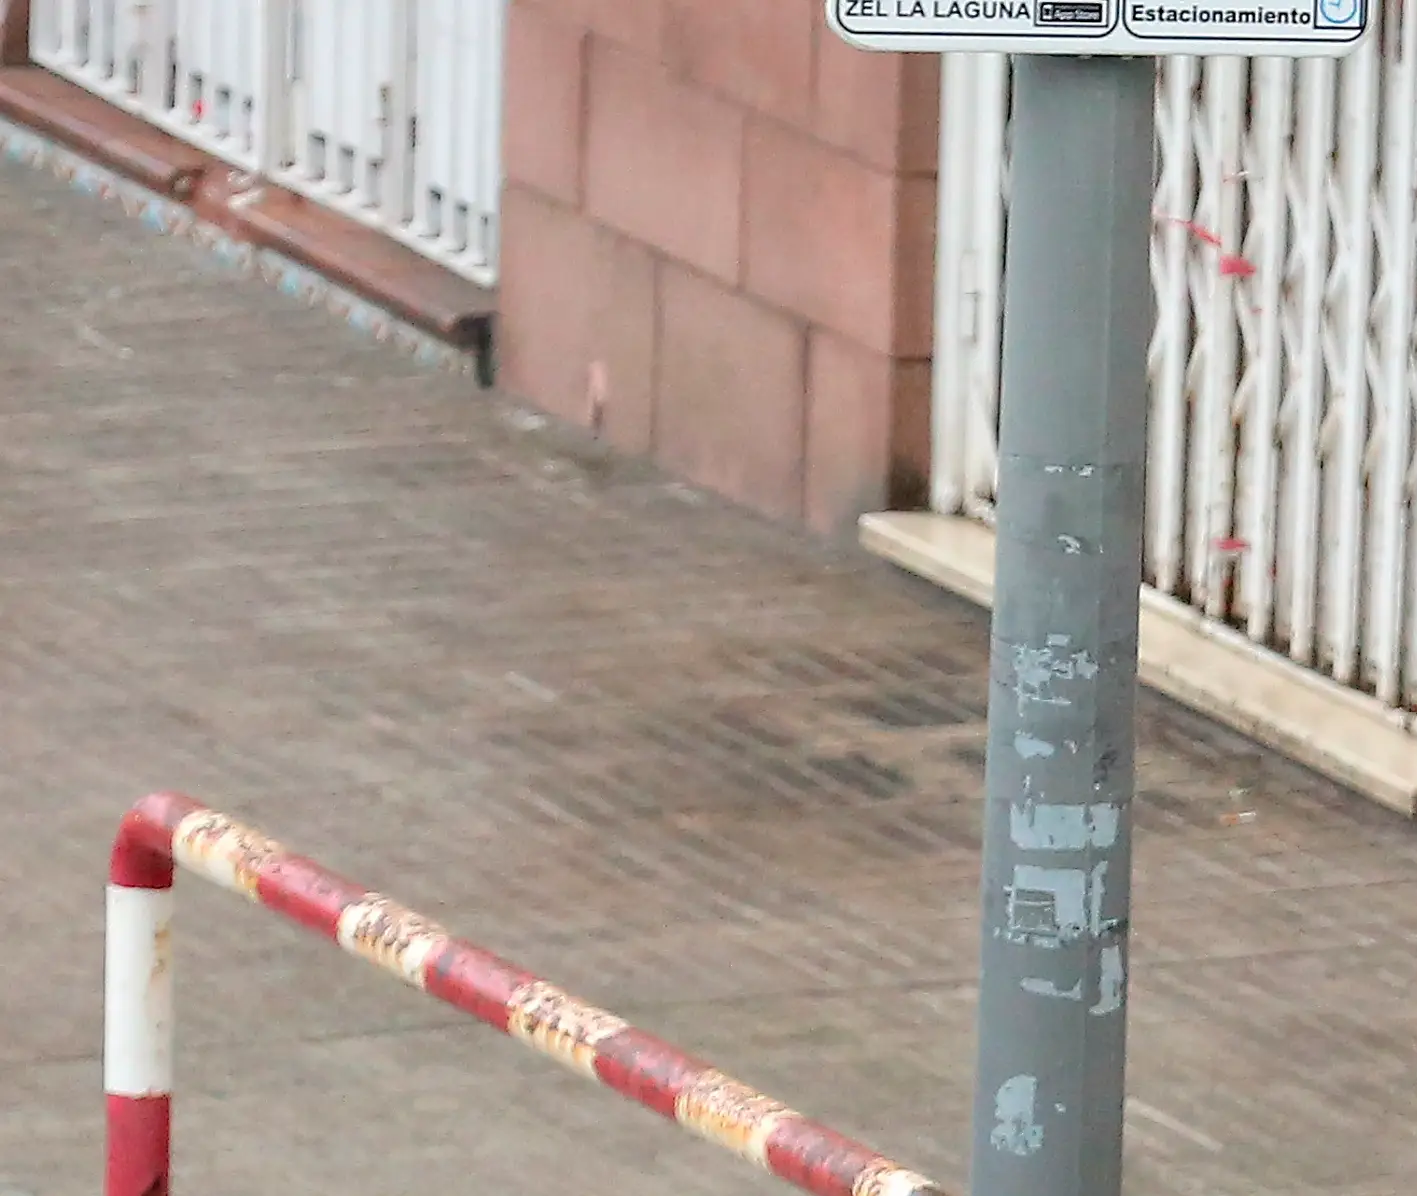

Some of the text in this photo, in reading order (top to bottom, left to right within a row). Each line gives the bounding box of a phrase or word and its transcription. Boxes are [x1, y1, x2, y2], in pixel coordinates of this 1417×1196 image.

[845, 0, 1031, 19] ZEL LA LAGUNA
[1131, 5, 1311, 24] Estacionamiento
